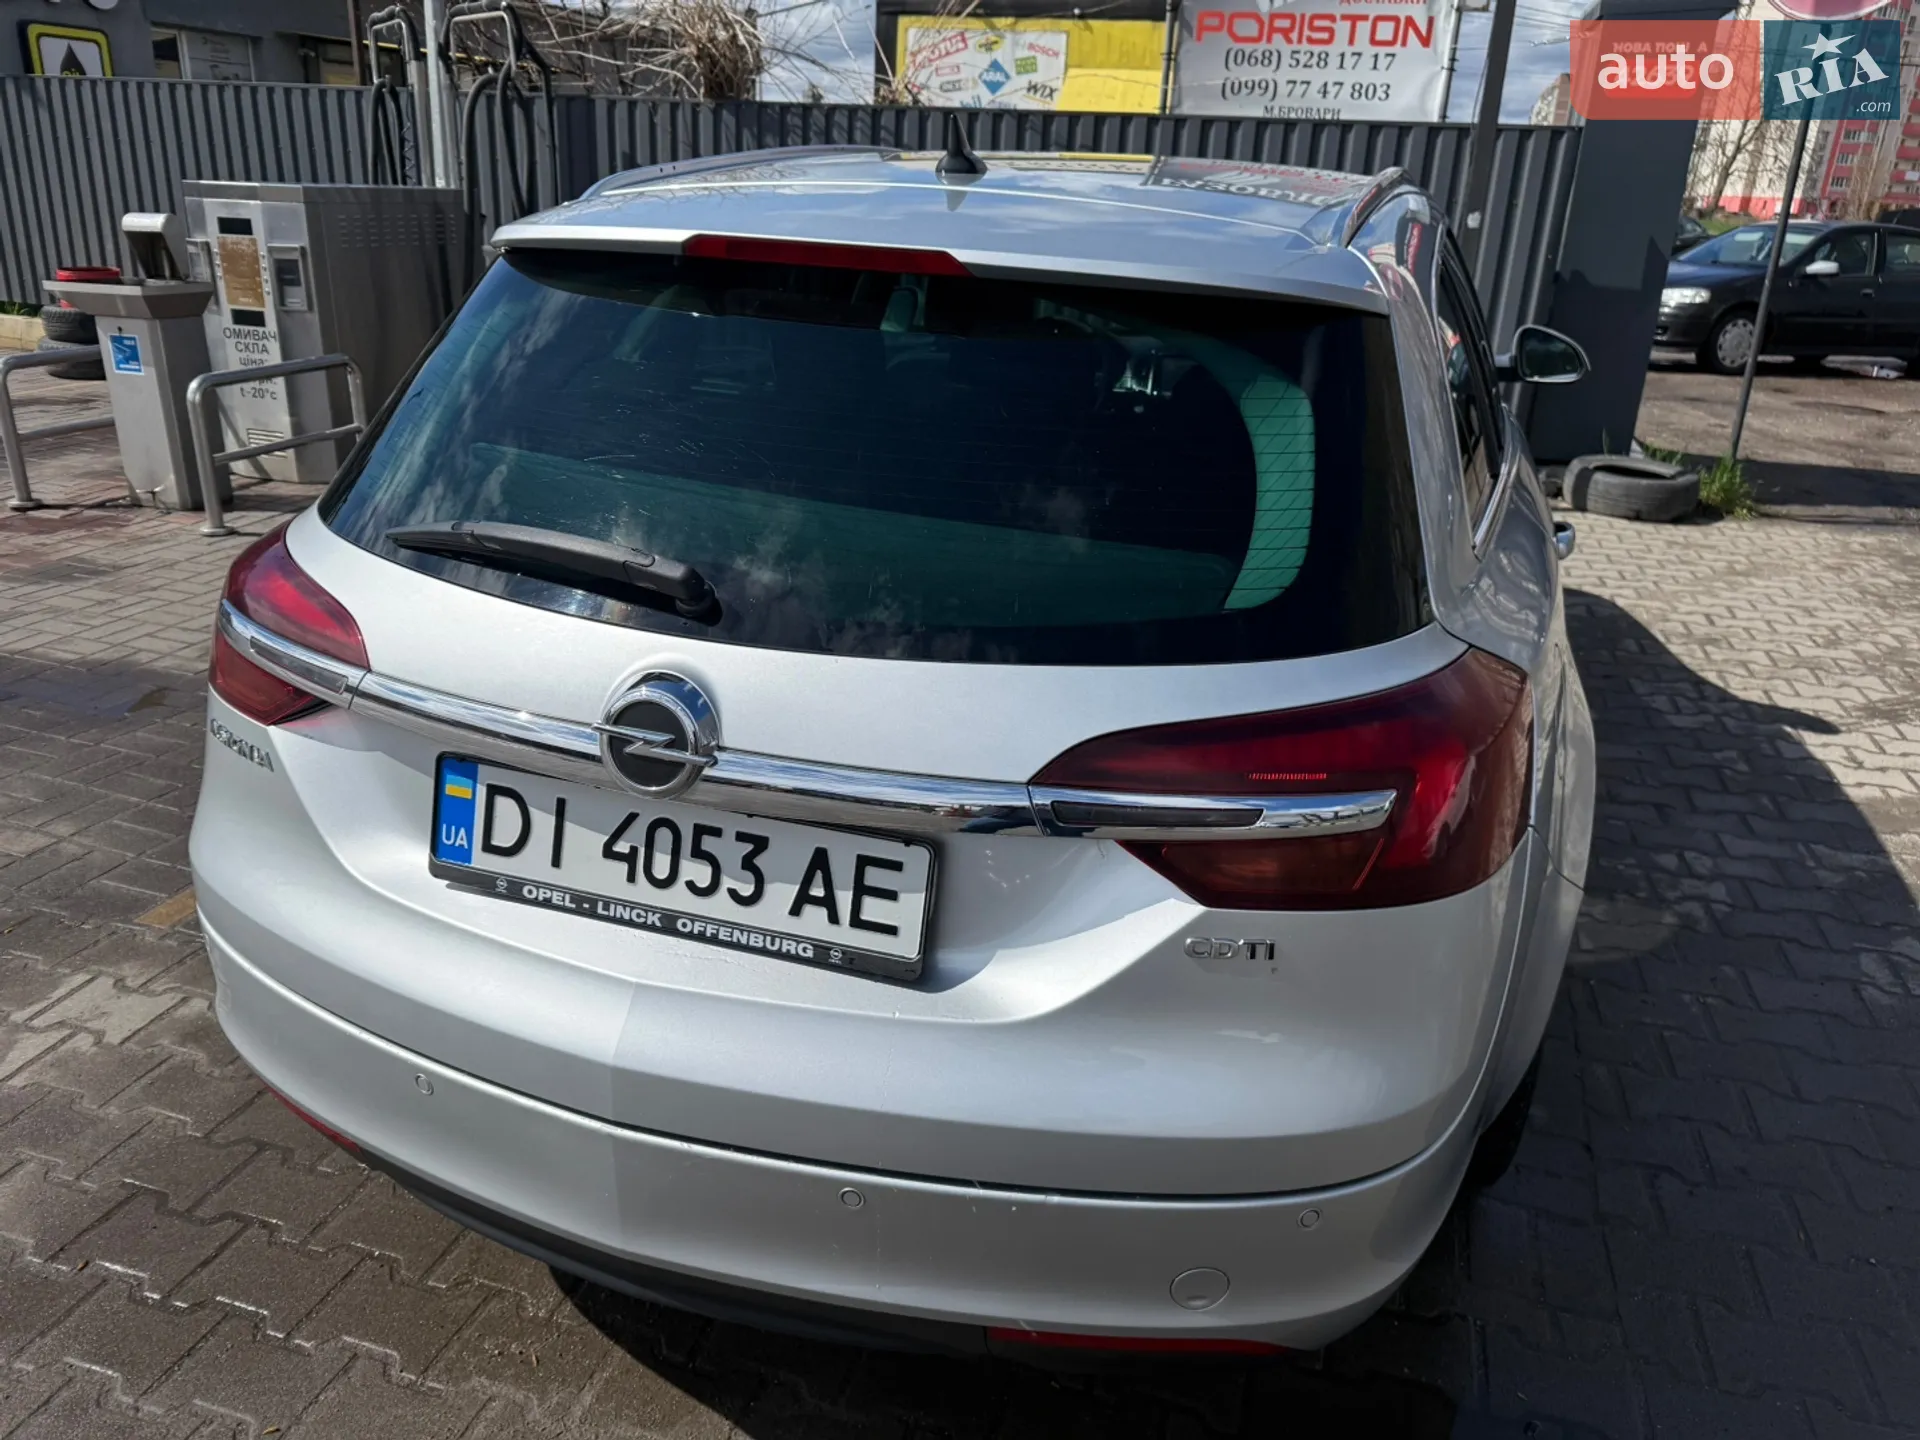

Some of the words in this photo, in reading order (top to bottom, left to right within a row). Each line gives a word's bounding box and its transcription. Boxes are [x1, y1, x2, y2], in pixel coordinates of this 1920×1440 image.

[1196, 10, 1435, 48] PORISTON
[1224, 47, 1281, 73] (068)
[1288, 49, 1329, 69] 528
[1336, 51, 1363, 71] 17
[1370, 52, 1396, 72] 17
[1221, 77, 1278, 102] (099)
[1286, 79, 1311, 99] 77
[1317, 80, 1344, 100] 47
[1350, 82, 1391, 101] 803
[223, 326, 277, 343] ОМИВАЧ
[234, 341, 270, 354] СКЛА
[442, 823, 468, 849] UA
[482, 783, 566, 869] DI
[602, 811, 770, 907] 4053
[788, 846, 904, 936] AE
[522, 885, 576, 908] OPEL
[597, 901, 662, 927] LINCK
[676, 918, 814, 958] OFFENBURG
[1184, 937, 1275, 960] CDTI
